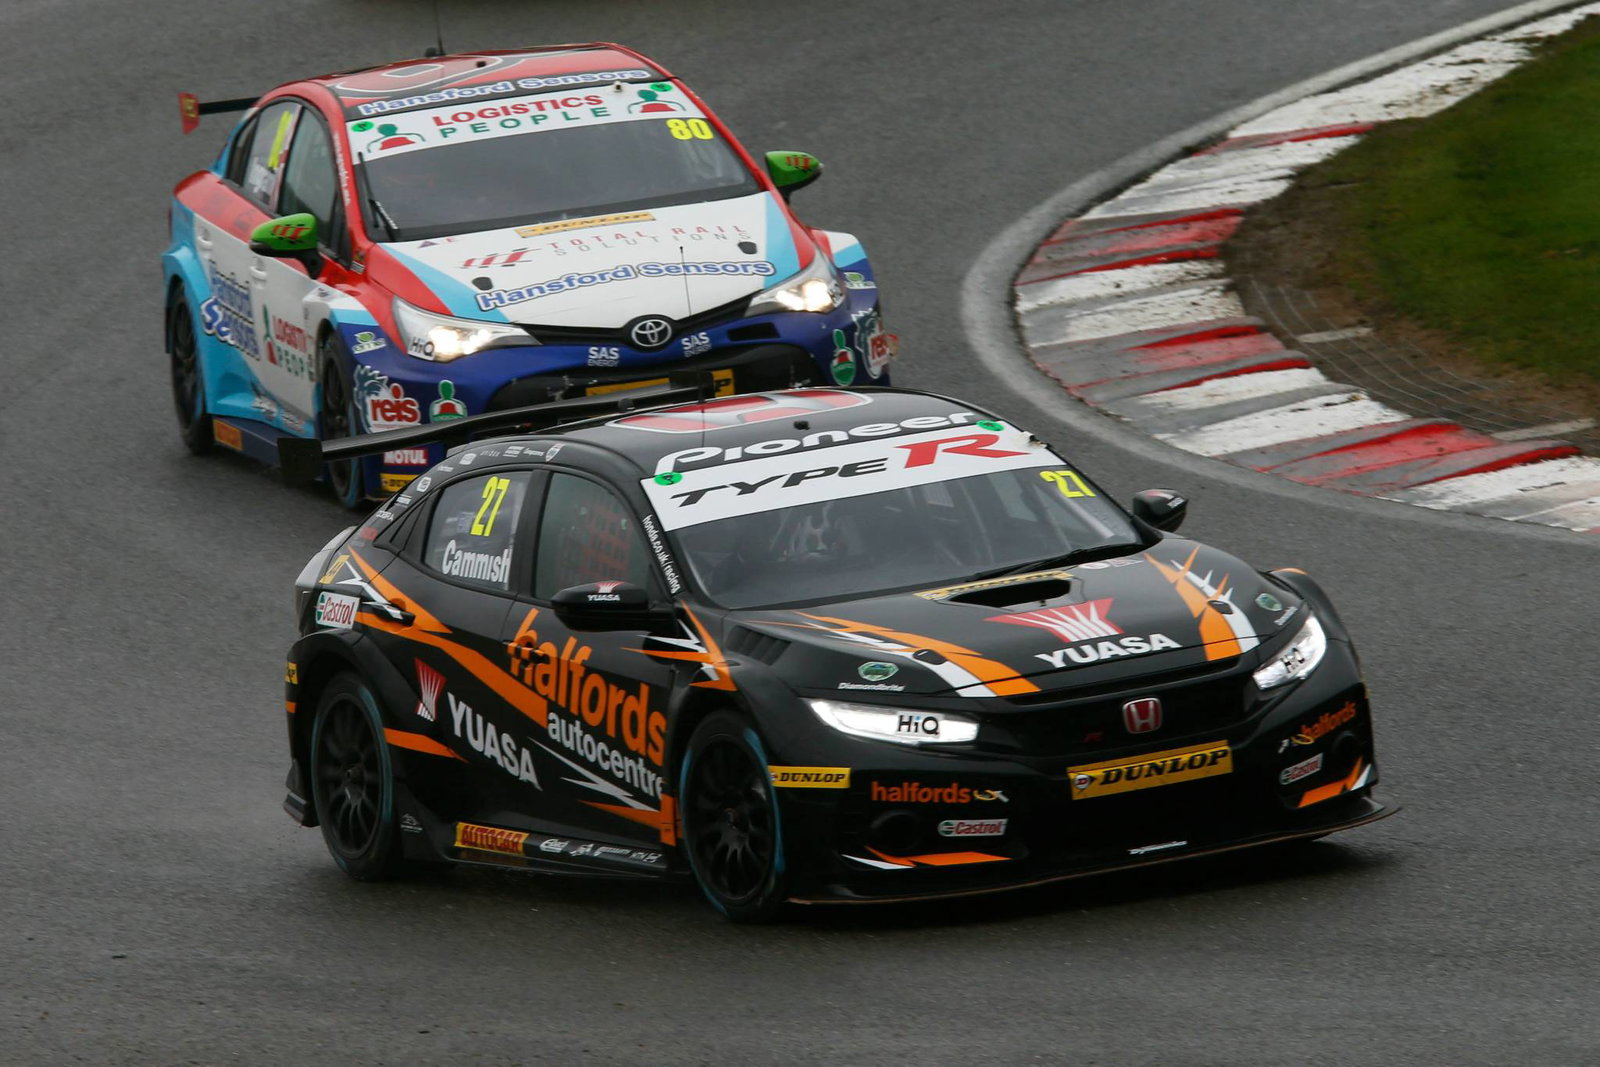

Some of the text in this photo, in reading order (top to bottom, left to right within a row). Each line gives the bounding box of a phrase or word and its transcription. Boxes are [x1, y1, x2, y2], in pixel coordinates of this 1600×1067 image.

[358, 68, 652, 117] Hansford Sensors
[432, 95, 604, 127] LOGISTICS
[441, 106, 611, 139] PEOPLE
[666, 118, 714, 140] 80
[548, 225, 746, 250] TOTAL RAIL
[553, 231, 752, 257] SOLUTIONS
[479, 260, 775, 311] Hansford Sensors
[410, 336, 435, 357] HiQ
[588, 346, 620, 360] SAS
[681, 331, 710, 350] SAS
[587, 359, 619, 367] ENERGY
[371, 384, 421, 423] reis
[655, 411, 974, 474] Pioneer
[384, 449, 427, 465] MOTUL
[670, 433, 1031, 508] TYPE R
[1040, 470, 1097, 498] 27
[470, 476, 510, 537] 27
[442, 539, 513, 584] Cammish
[322, 597, 356, 625] Castrol
[587, 594, 621, 602] YUASA
[1034, 633, 1183, 669] YUASA
[508, 608, 667, 767] halfords
[896, 714, 941, 736] HiQ
[1301, 701, 1356, 739] halfords
[447, 691, 543, 792] YUASA
[779, 771, 846, 784] DUNLOP
[1099, 748, 1229, 786] DUNLOP
[872, 780, 971, 804] halfords
[461, 824, 526, 852] AUTOCAR
[955, 820, 1003, 835] Castrol
